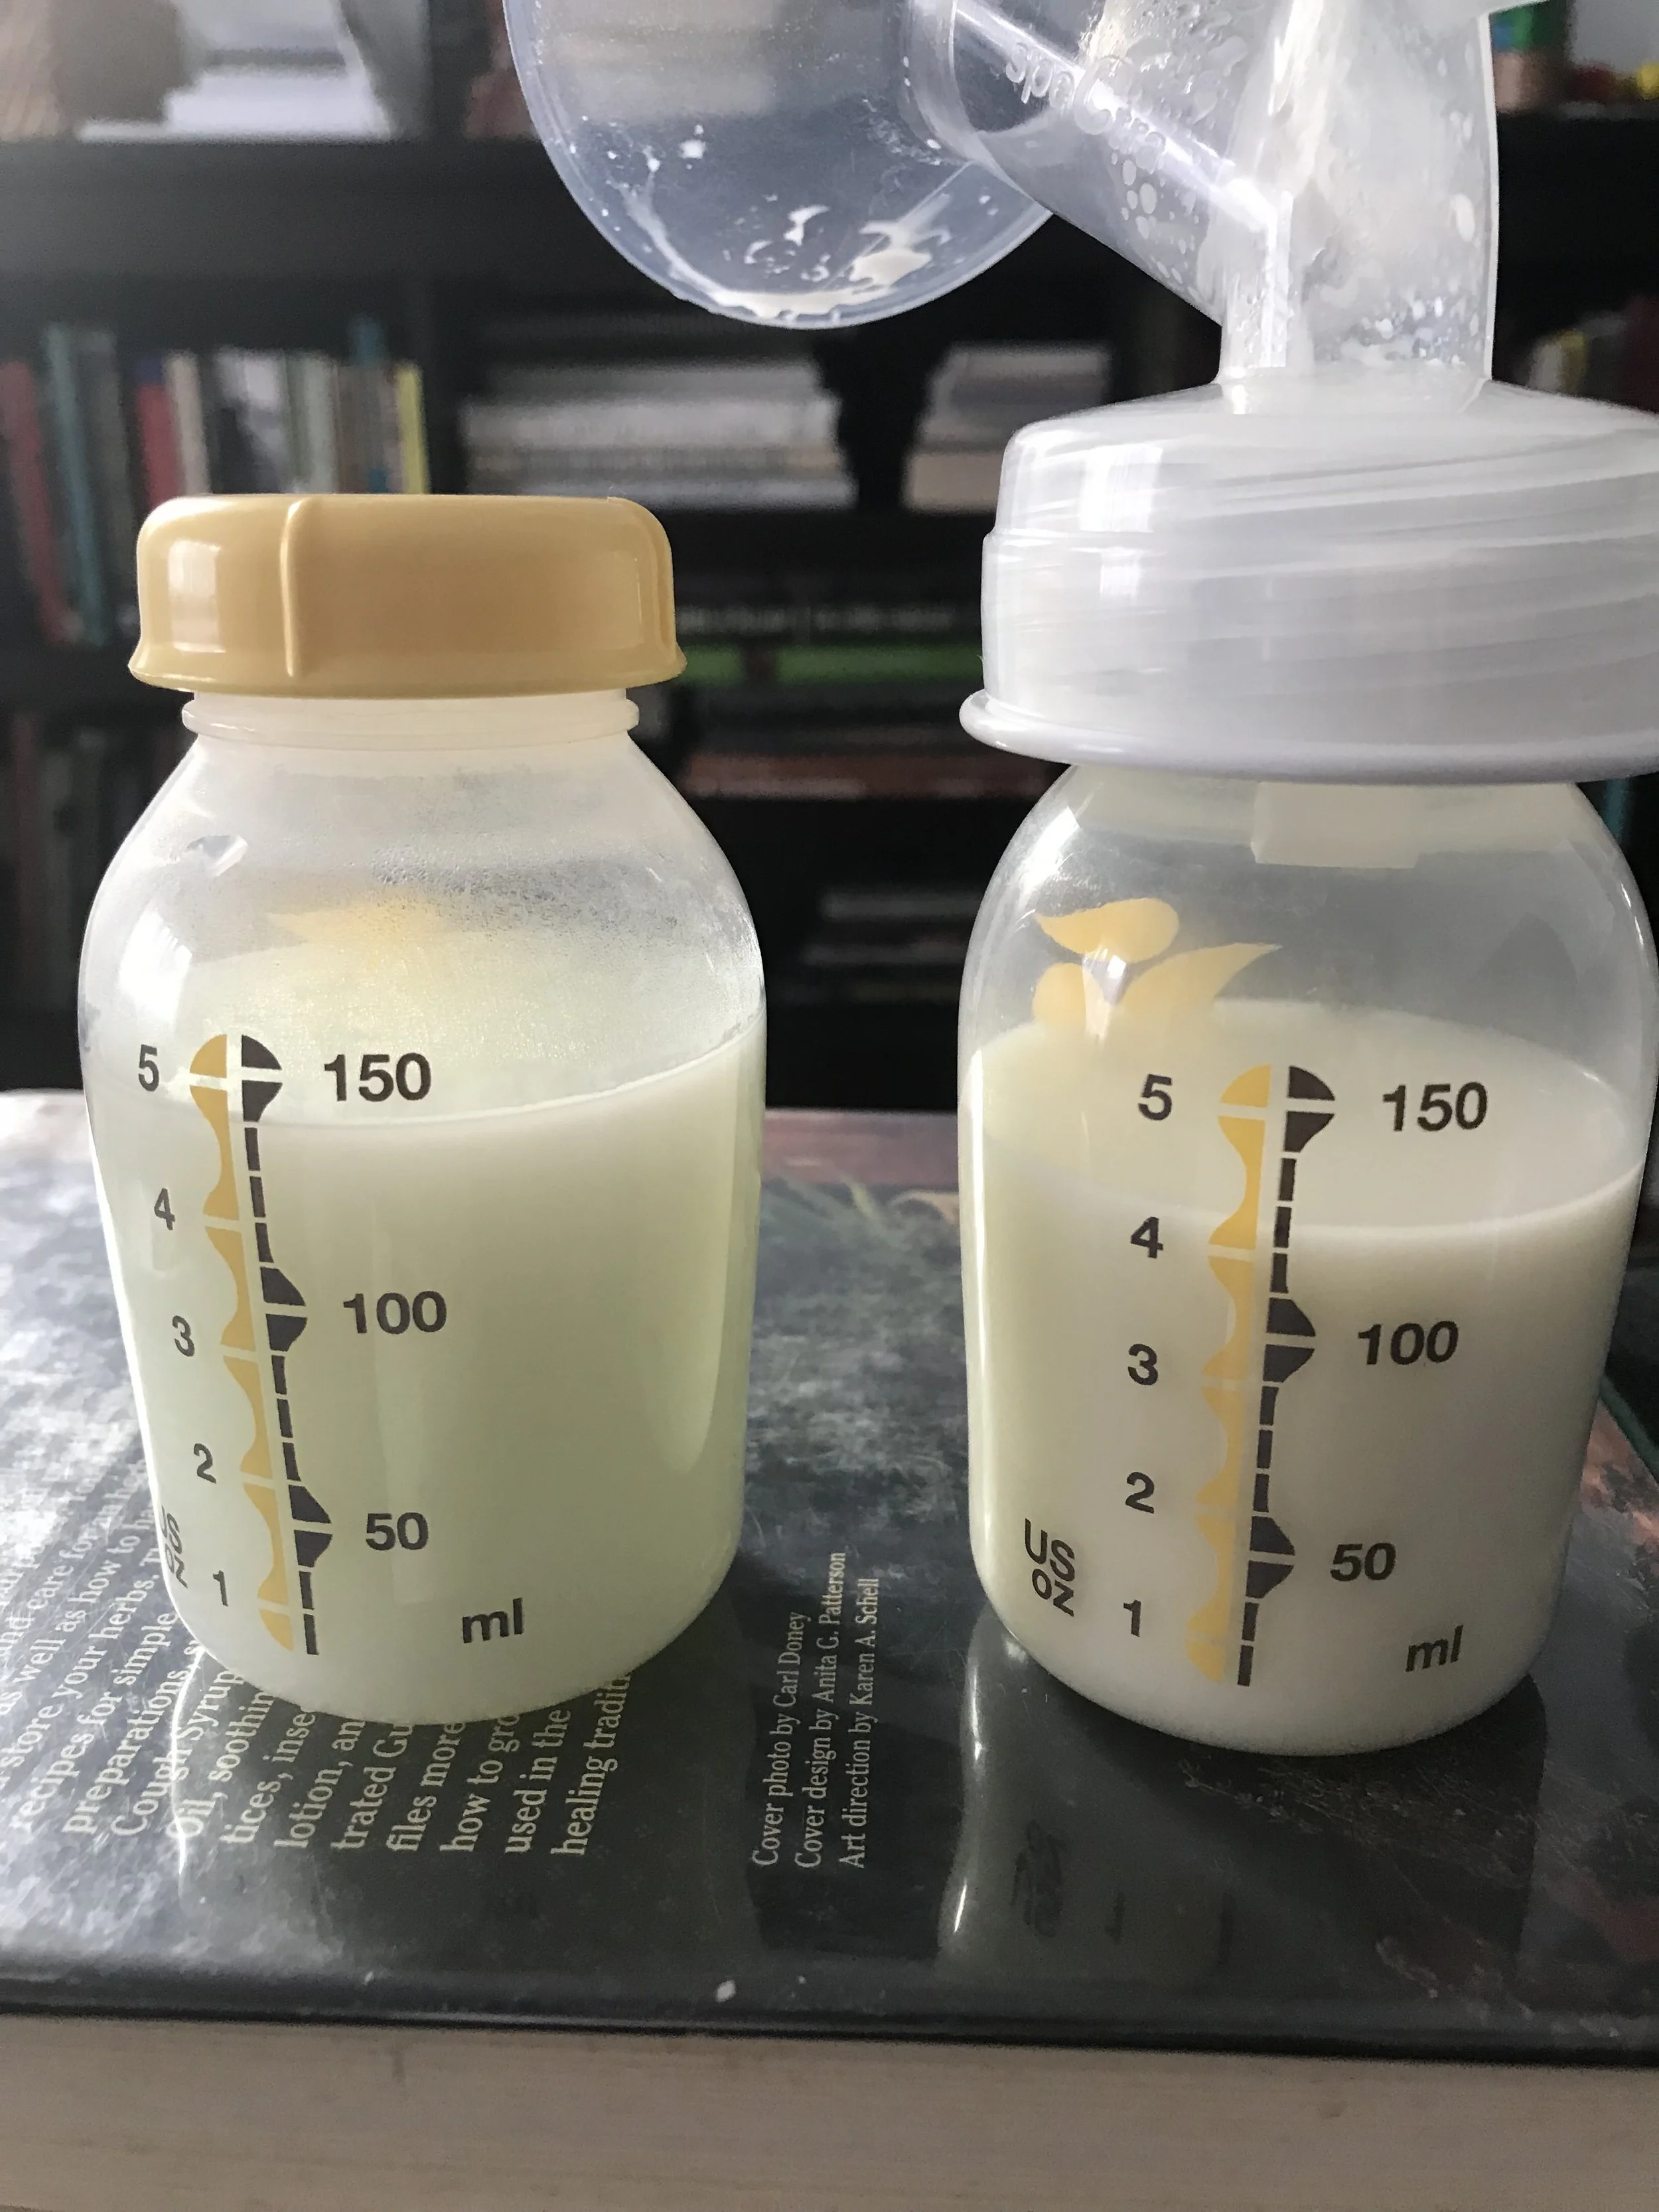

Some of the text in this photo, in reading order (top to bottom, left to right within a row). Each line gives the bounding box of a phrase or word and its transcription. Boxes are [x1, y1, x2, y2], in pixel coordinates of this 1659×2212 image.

[138, 1044, 159, 1092] 5
[324, 1052, 431, 1102] 150
[1138, 1073, 1173, 1121] 5
[1382, 1082, 1488, 1132] 150
[154, 1188, 175, 1230] 4
[1130, 1217, 1163, 1259] 4
[173, 1315, 194, 1357] 3
[343, 1290, 447, 1335] 100
[1127, 1344, 1159, 1385] 3
[1358, 1321, 1459, 1365] 100
[194, 1443, 216, 1484] 2
[1125, 1471, 1155, 1514] 2
[106, 1535, 141, 1554] to
[366, 1512, 429, 1551] 50
[1025, 1518, 1076, 1582] US
[67, 1560, 121, 1603] how
[1330, 1542, 1396, 1581] 50
[27, 1564, 74, 1610] care
[213, 1570, 228, 1606] 1
[818, 1552, 846, 1625] Patterson
[51, 1645, 107, 1699] your
[88, 1574, 160, 1640] herbs.
[54, 1609, 87, 1633] as
[462, 1597, 524, 1644] ml
[1123, 1599, 1141, 1637] 1
[12, 1639, 66, 1683] well
[1405, 1624, 1464, 1672] ml
[812, 1654, 837, 1702] Anita
[9, 1613, 179, 1832] recipes for simple
[752, 1611, 812, 1866] Cover photo by Carl Doney
[809, 1708, 839, 1730] by
[838, 1578, 879, 1868] Art direction by Karen A. Schell
[111, 1670, 244, 1835] Cough Syrup
[219, 1706, 317, 1844] tices, inse
[802, 1737, 837, 1799] design
[274, 1761, 354, 1849] lotion,
[386, 1724, 465, 1852] files more
[505, 1710, 571, 1853] used in the
[166, 1792, 228, 1838] Oil,
[330, 1767, 397, 1849] trated
[439, 1793, 490, 1852] how
[467, 1760, 503, 1784] to
[550, 1756, 618, 1856] healing
[794, 1805, 824, 1868] Cover
